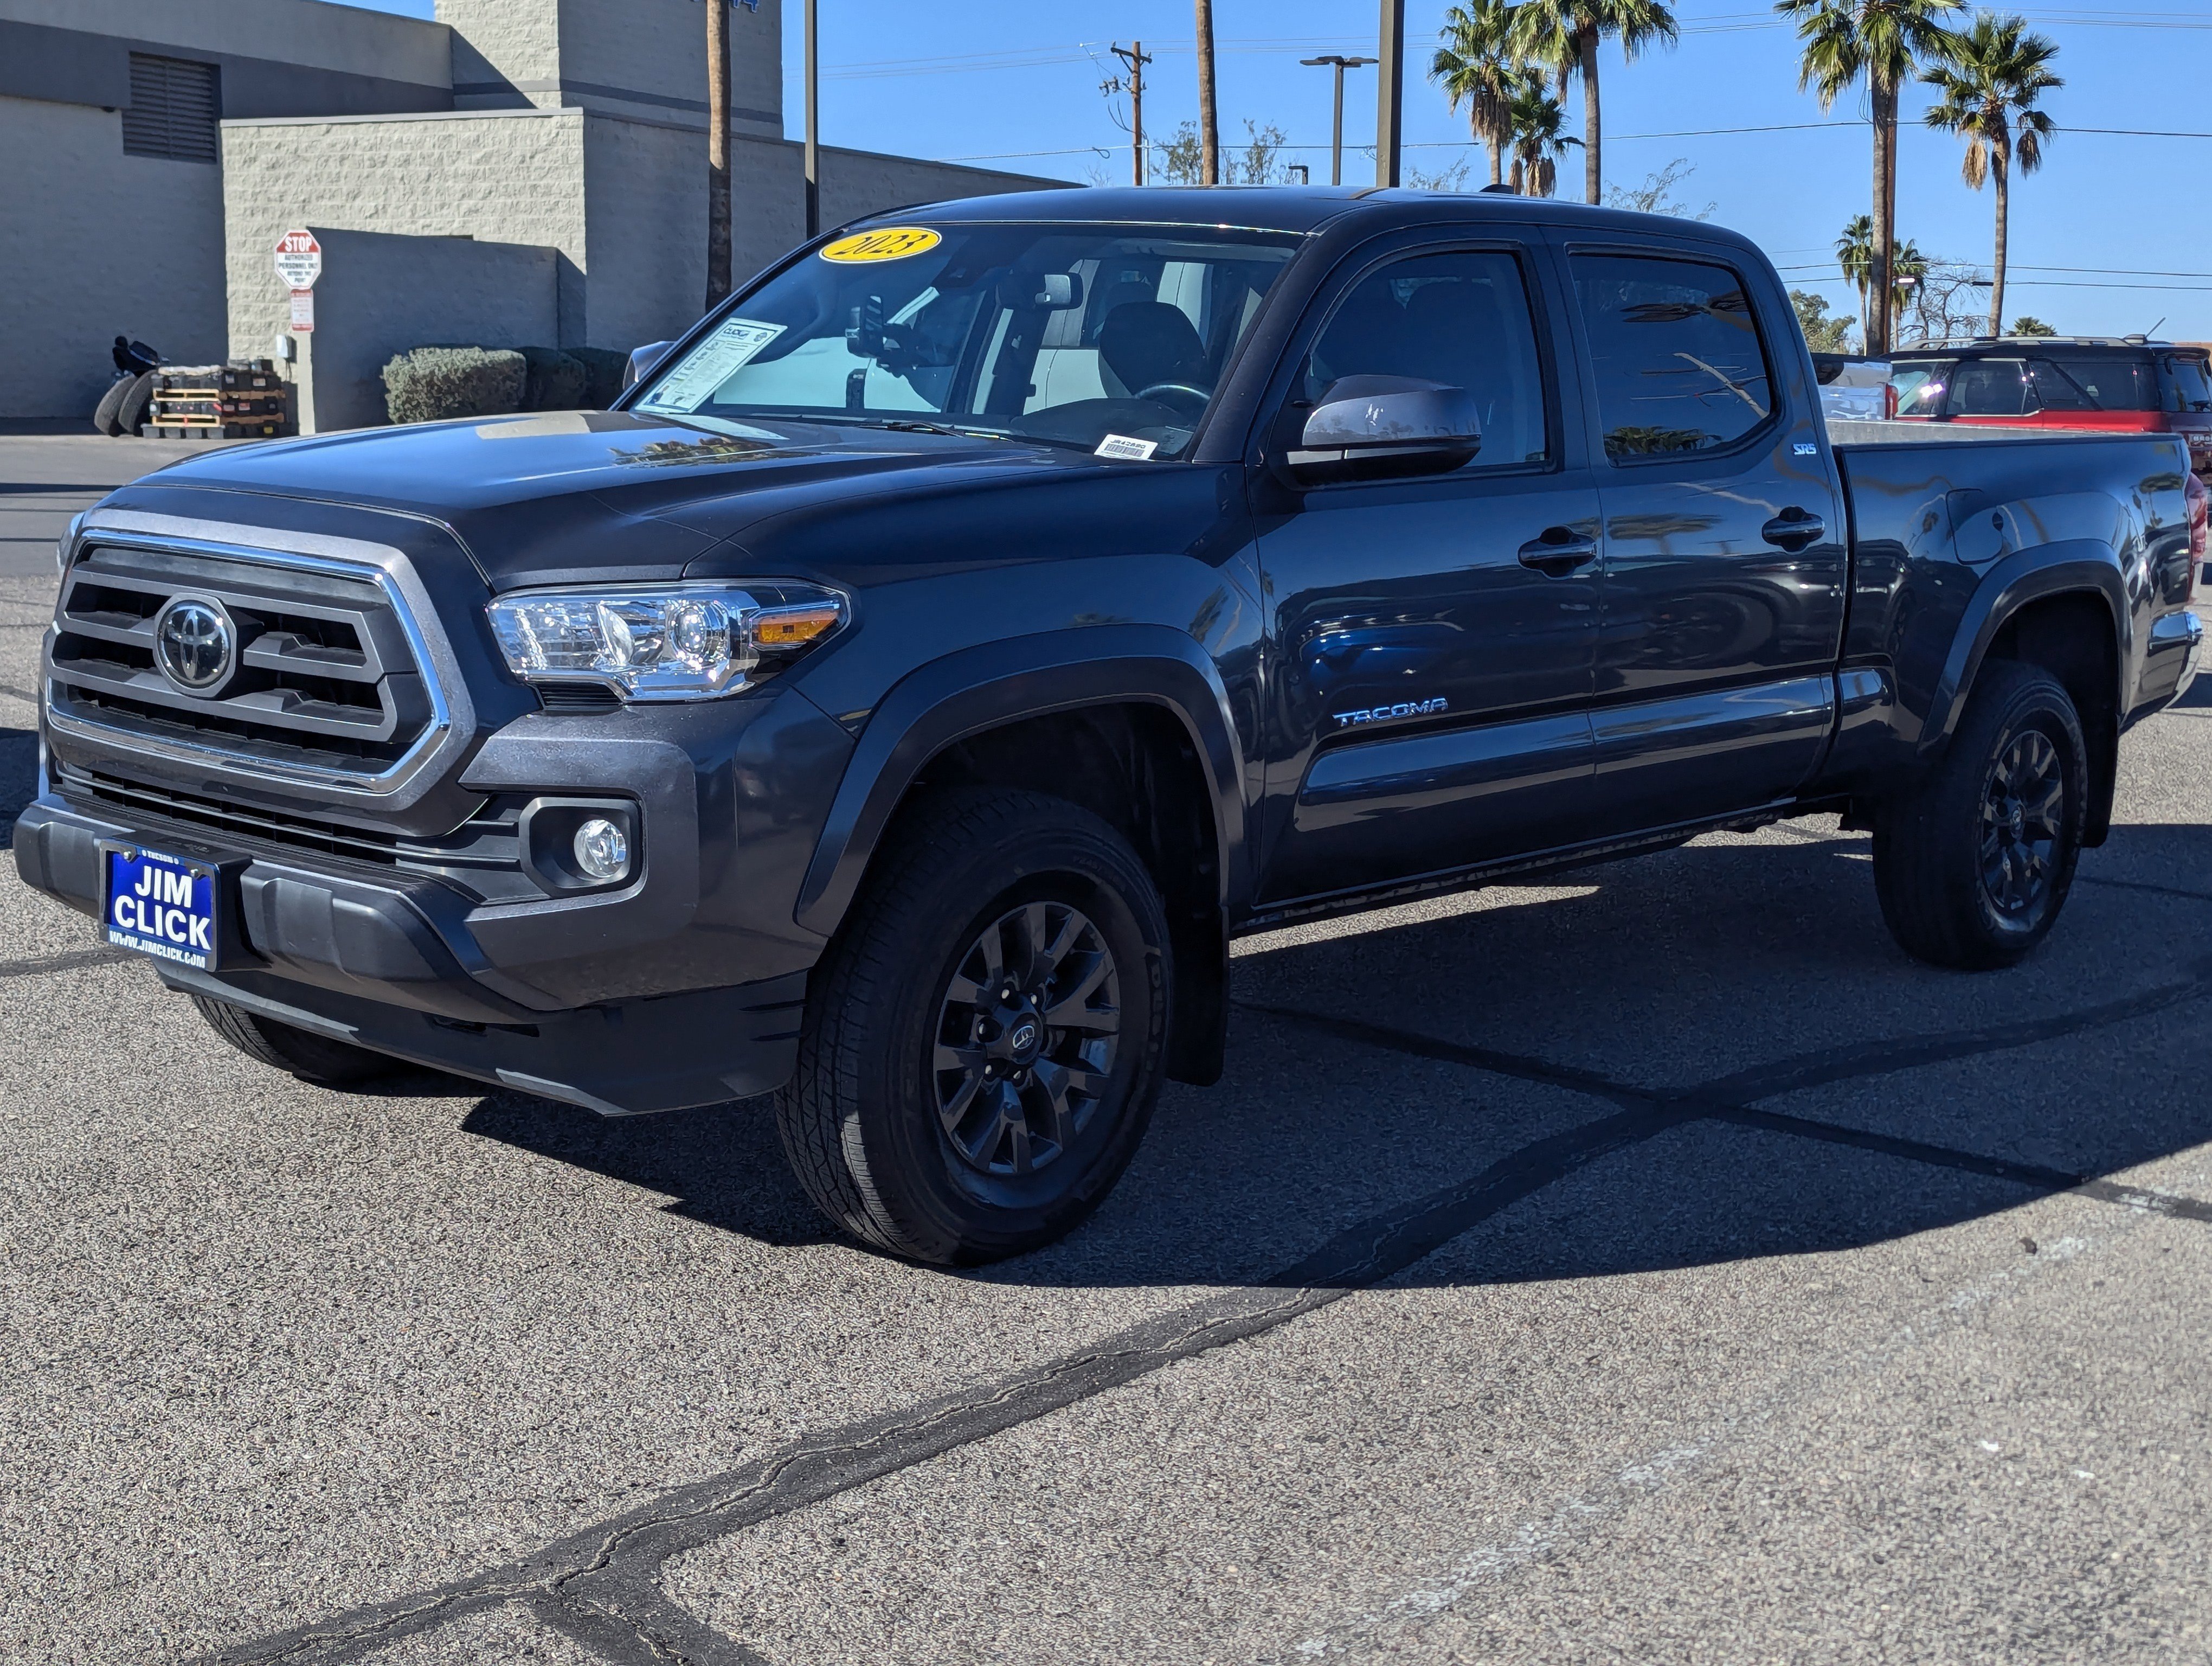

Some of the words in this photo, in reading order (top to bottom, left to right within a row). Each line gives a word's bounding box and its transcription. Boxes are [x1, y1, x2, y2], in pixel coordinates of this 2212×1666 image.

[285, 236, 312, 252] STOP
[831, 234, 929, 255] 2023
[1332, 697, 1448, 727] TACOMA
[147, 850, 173, 863] TUCSON
[134, 865, 192, 908] JIM
[114, 895, 211, 951] CLICK
[110, 930, 206, 969] WWW.JIMCLICK.COM
